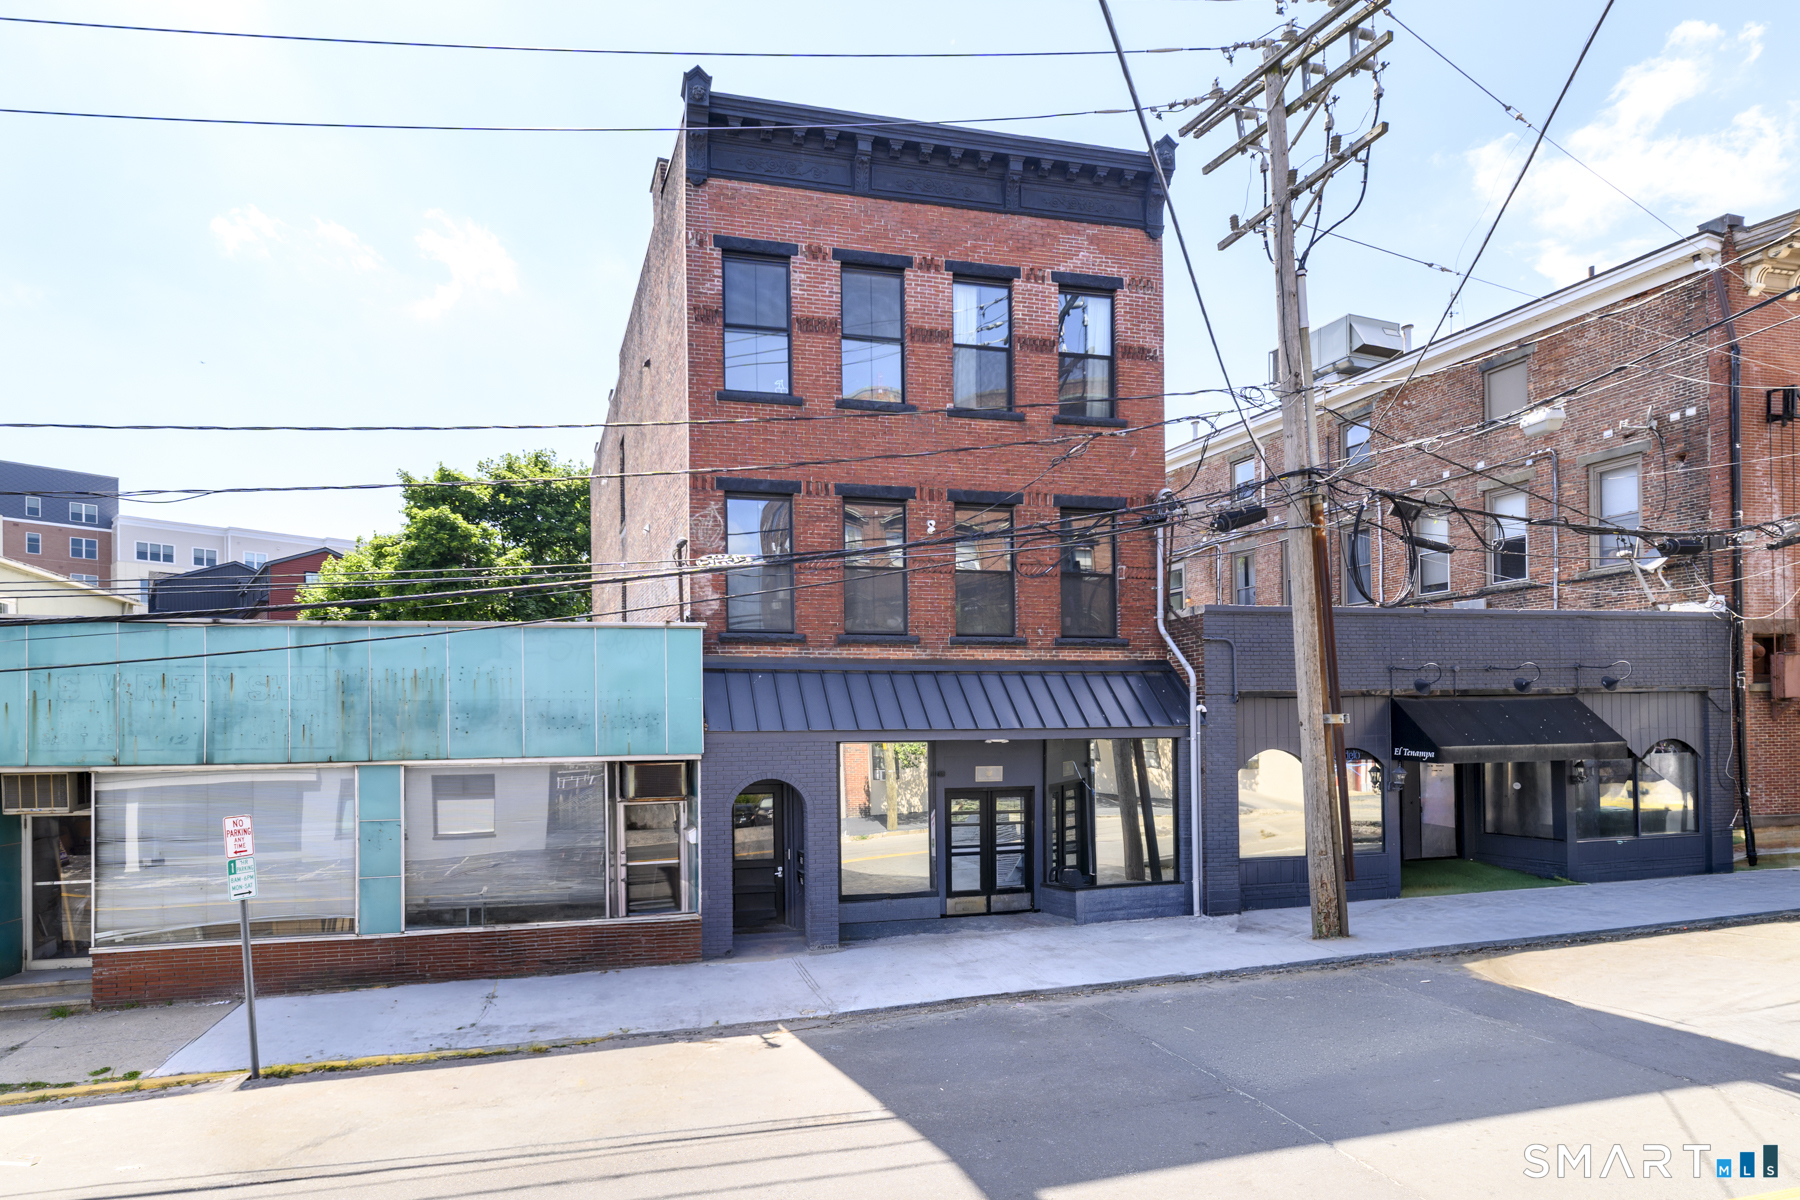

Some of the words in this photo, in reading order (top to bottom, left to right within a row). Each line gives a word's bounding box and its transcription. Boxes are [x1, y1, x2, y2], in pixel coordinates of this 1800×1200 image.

[97, 673, 236, 701] VRIETY
[248, 674, 330, 701] SHOP
[1394, 747, 1403, 756] El
[1403, 748, 1435, 760] Tenampa
[233, 819, 244, 828] NO
[227, 828, 251, 838] PARKING
[231, 863, 234, 874] 1
